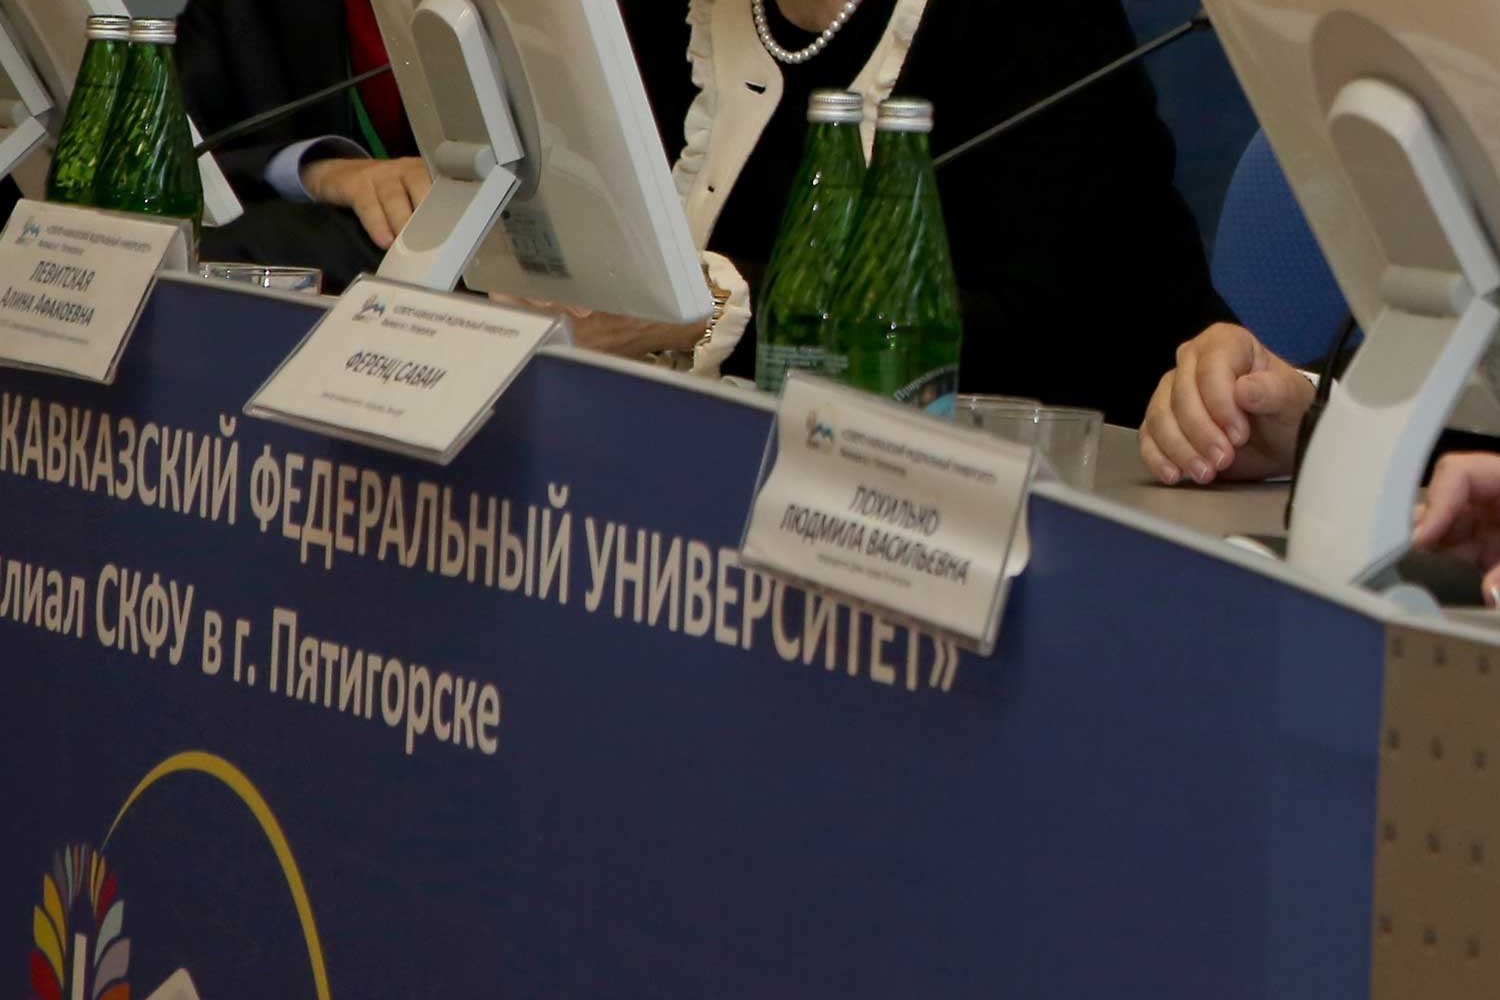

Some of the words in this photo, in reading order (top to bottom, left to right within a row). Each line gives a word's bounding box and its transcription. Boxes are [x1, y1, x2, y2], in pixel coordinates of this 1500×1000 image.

[345, 349, 402, 384] ФЕРЕНЦ
[0, 391, 238, 526] КАВКАЗСКИЙ
[249, 443, 572, 605] ФЕДЕРАЛЬНЫЙ
[780, 503, 865, 553] ЛЮДМИЛА
[864, 529, 972, 584] ВАСИЛЬЕВНА
[0, 555, 86, 639] лиал
[96, 563, 194, 666] СКФУ
[202, 610, 222, 675] в
[233, 618, 256, 687] г.
[270, 606, 501, 756] Пятигорске
